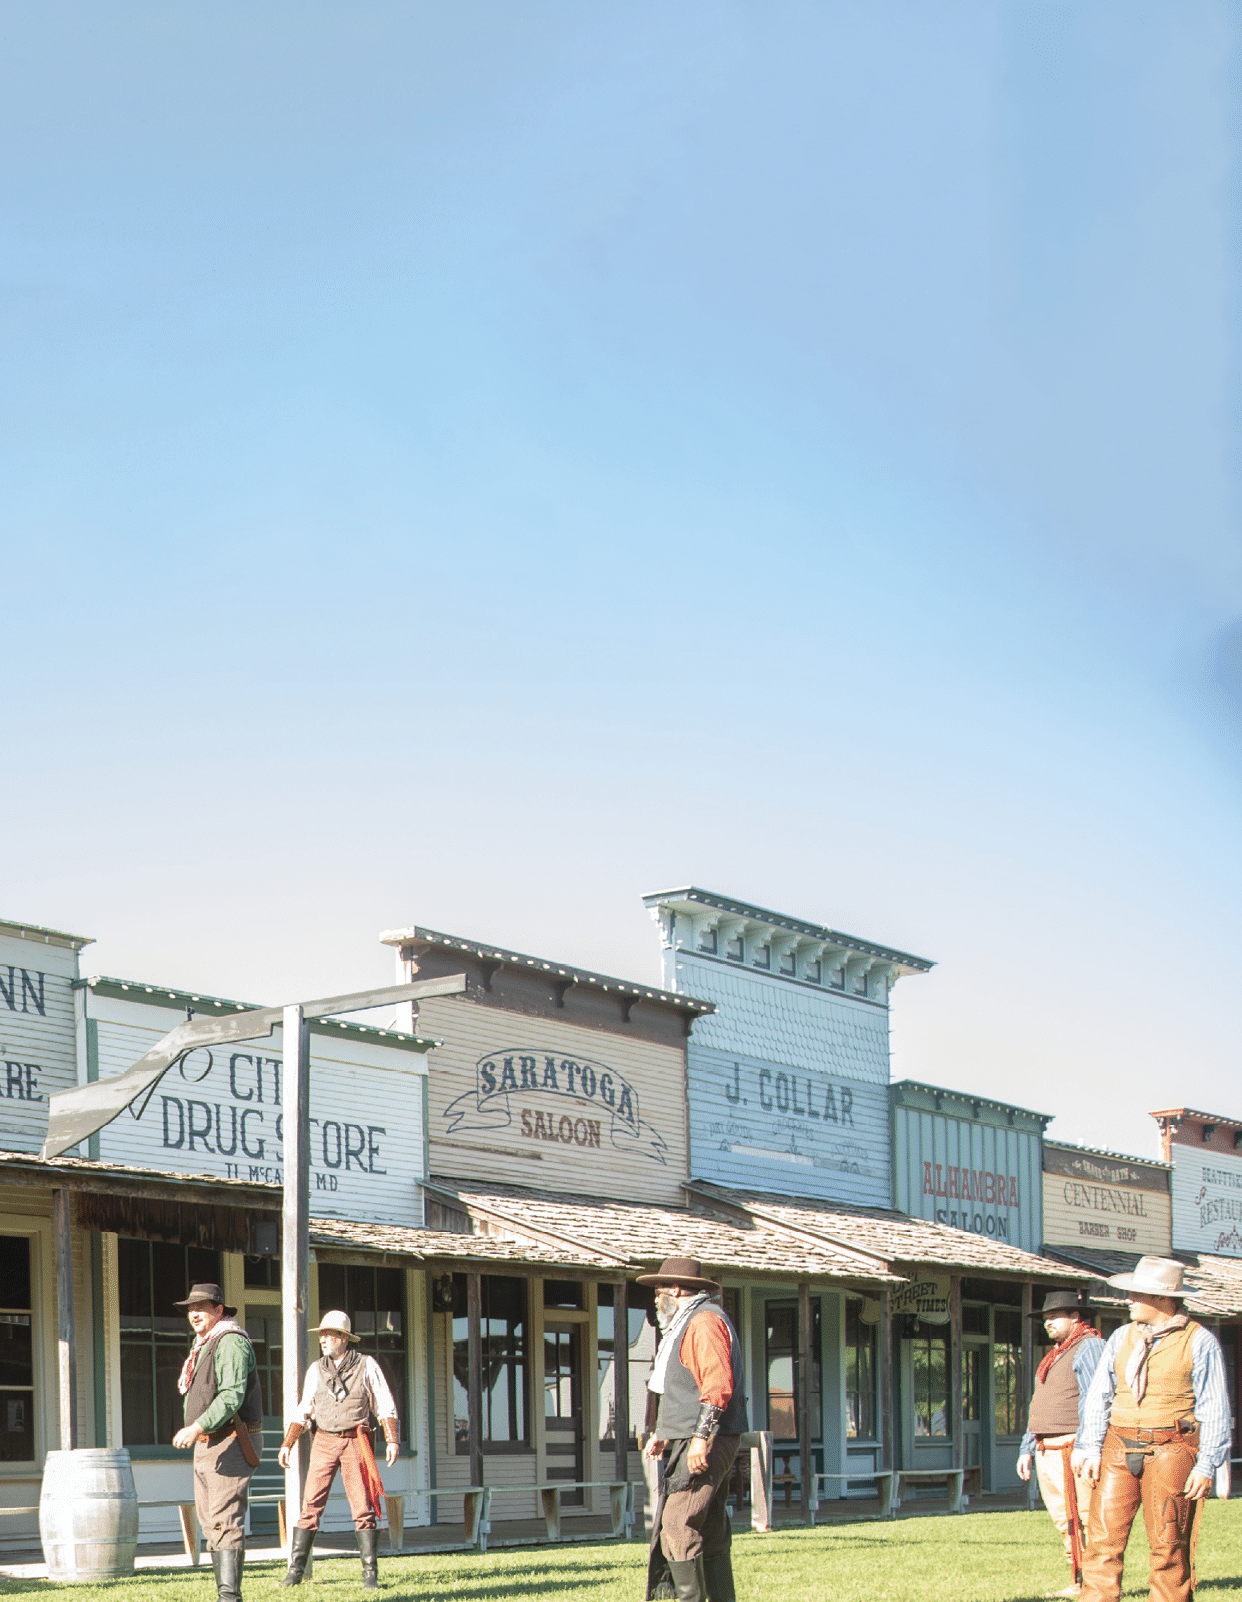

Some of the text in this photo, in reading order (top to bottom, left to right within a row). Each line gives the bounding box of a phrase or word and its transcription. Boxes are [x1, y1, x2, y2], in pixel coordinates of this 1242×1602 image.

[229, 1053, 283, 1106] CIT
[480, 1056, 636, 1125] SARATOGA
[724, 1061, 855, 1128] J. COLLAR
[159, 1094, 266, 1160] DRUG
[521, 1108, 601, 1149] SALOON
[923, 1161, 1019, 1208] ALHAMBRA
[1063, 1181, 1147, 1217] CENTENNIAL
[936, 1208, 1008, 1238] SALOON
[1078, 1220, 1137, 1242] BARBER SHOP
[916, 1298, 946, 1313] TIMES
